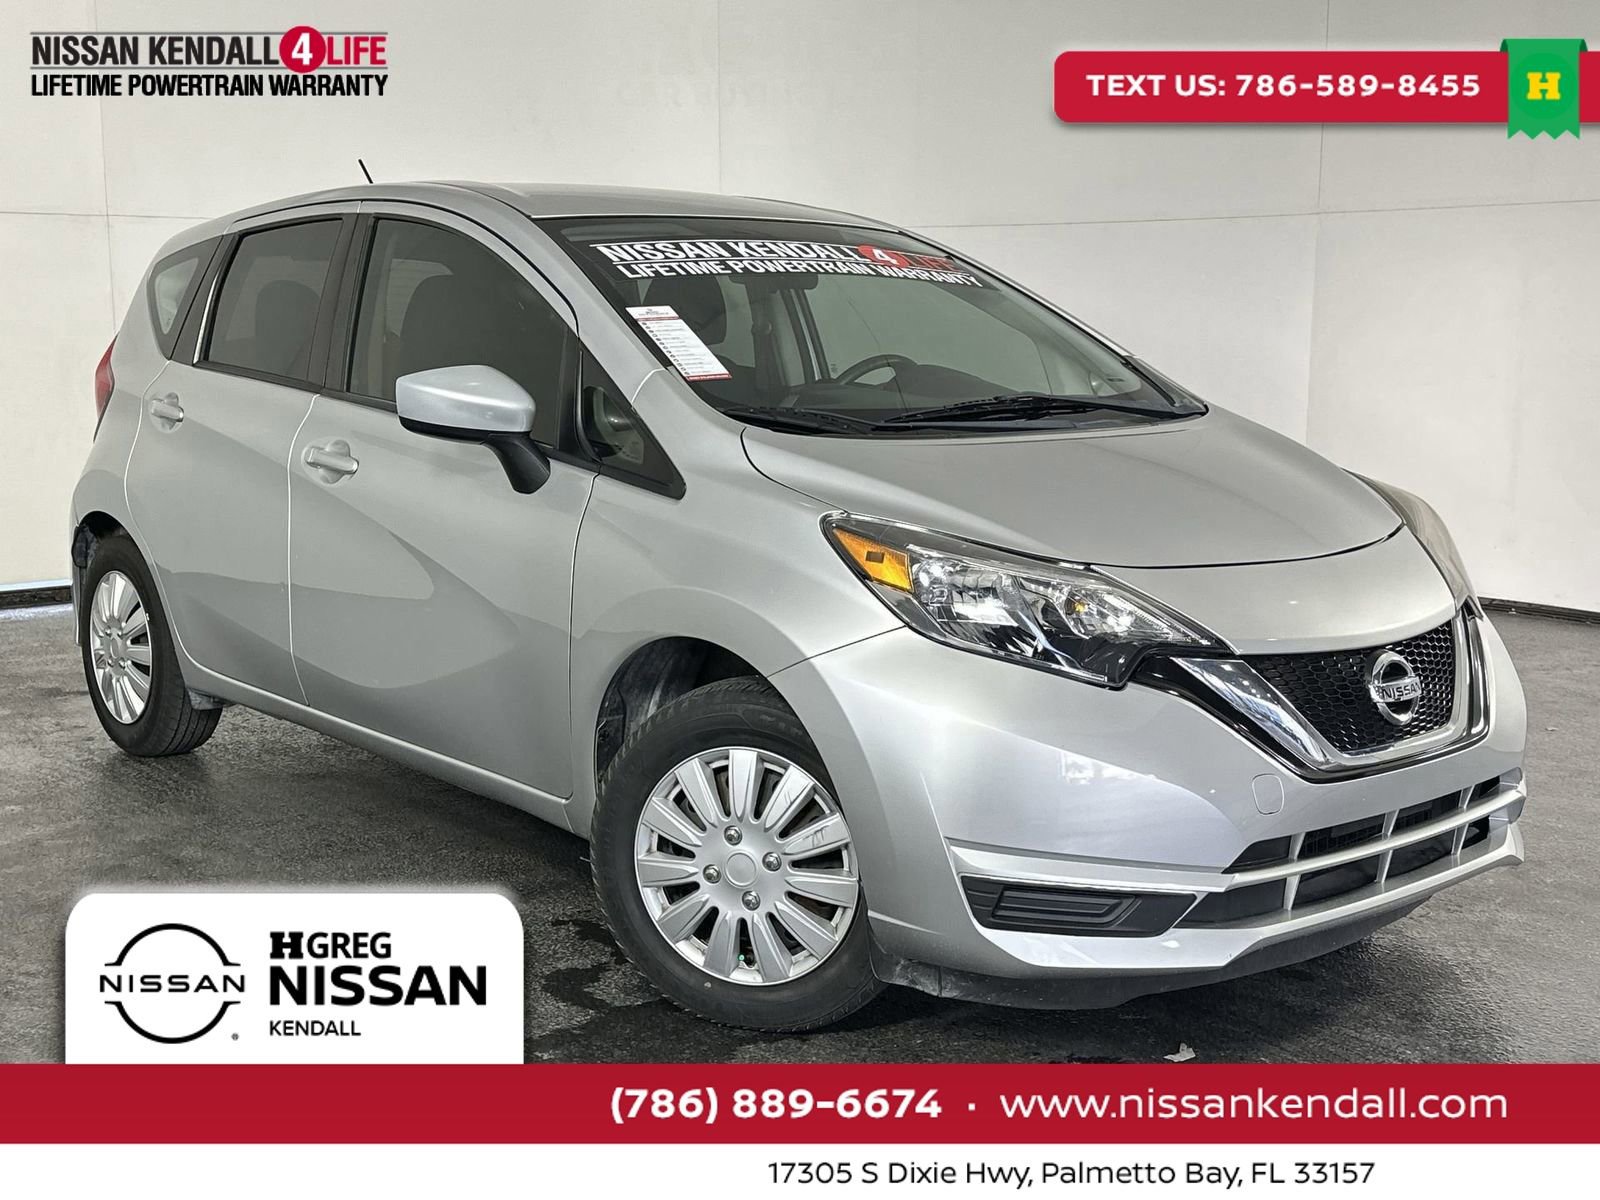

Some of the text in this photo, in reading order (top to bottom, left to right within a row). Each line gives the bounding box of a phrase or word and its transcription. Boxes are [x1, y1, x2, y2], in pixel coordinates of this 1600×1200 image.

[596, 242, 732, 261] NISSAN
[726, 241, 872, 261] KENDALL
[616, 260, 983, 288] LIFETIME POWERTRAIN WARRANTY
